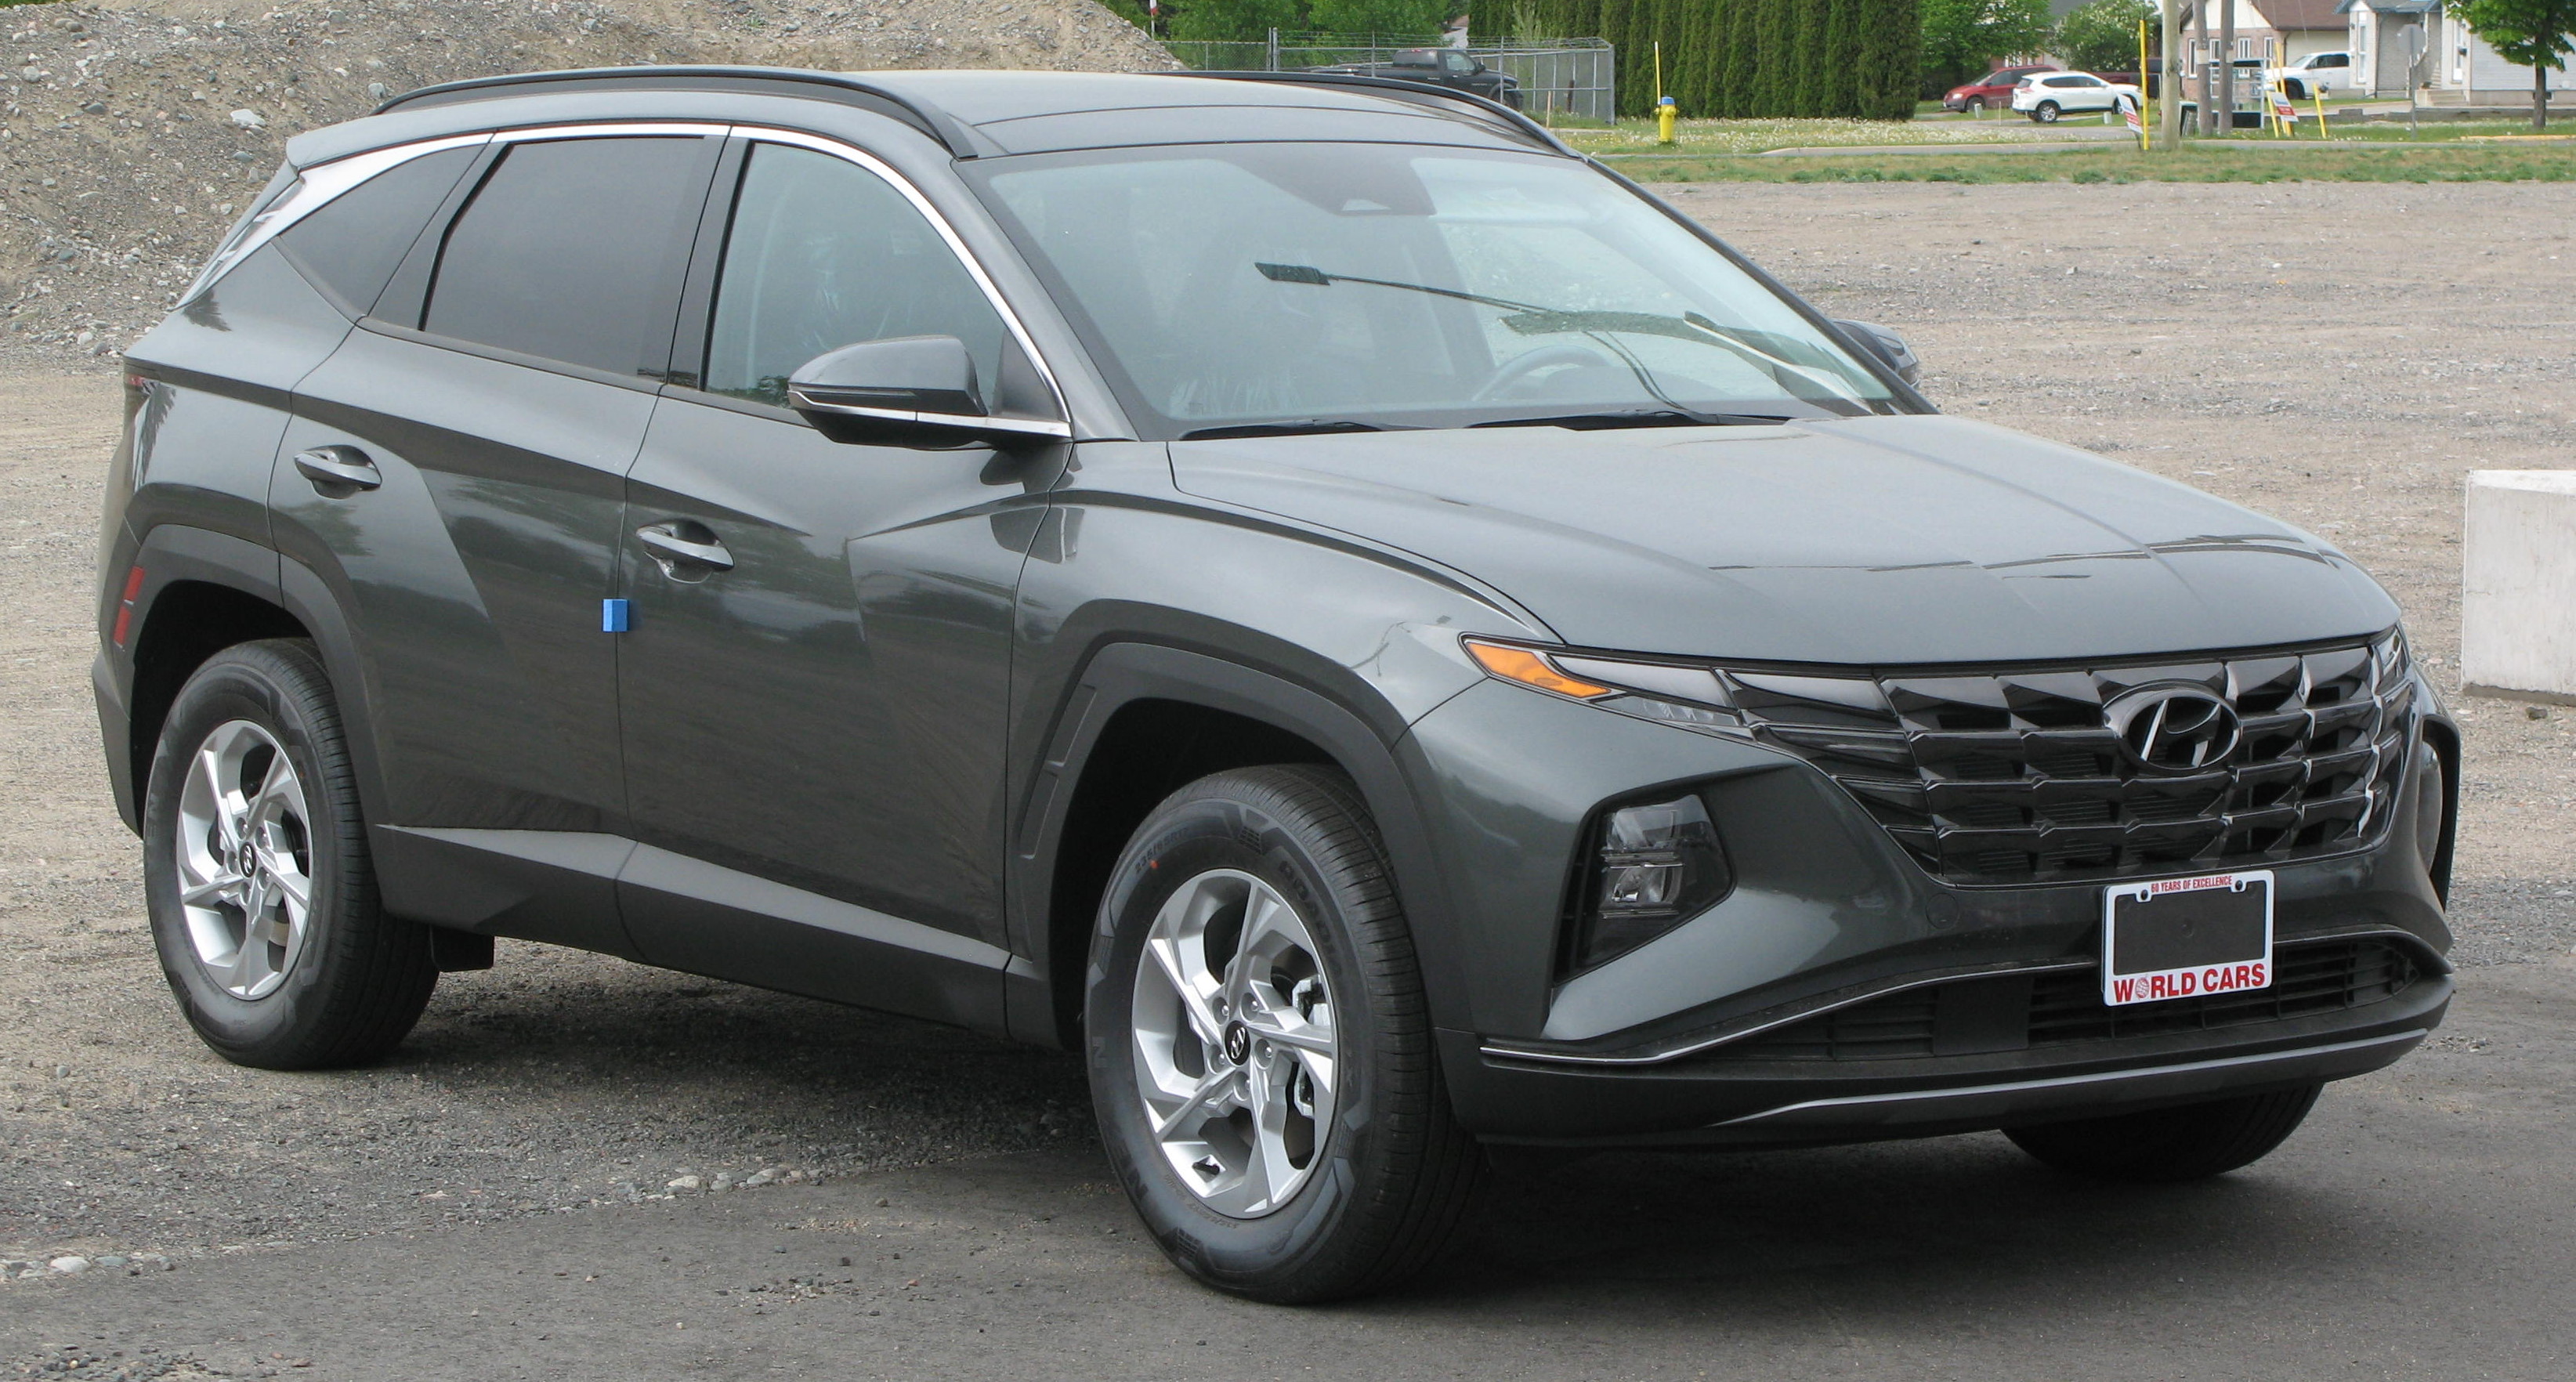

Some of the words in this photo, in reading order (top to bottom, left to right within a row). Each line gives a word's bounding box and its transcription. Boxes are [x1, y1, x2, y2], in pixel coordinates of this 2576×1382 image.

[2161, 881, 2181, 892] YEARS
[2183, 880, 2191, 889] OF
[2193, 876, 2232, 888] EXCELLENCE
[2114, 972, 2196, 1003] WORLD
[2203, 963, 2265, 992] CARS
